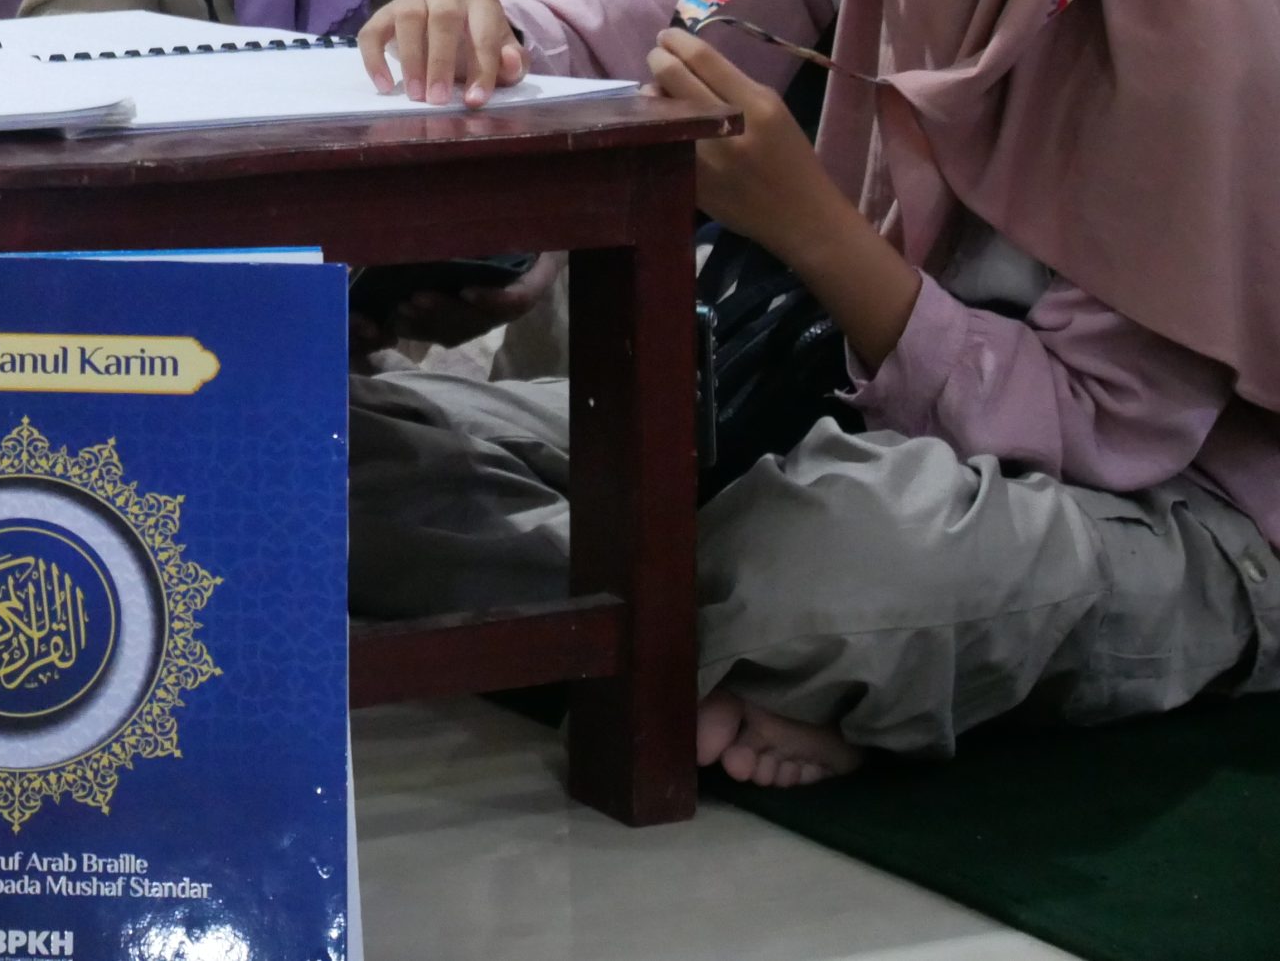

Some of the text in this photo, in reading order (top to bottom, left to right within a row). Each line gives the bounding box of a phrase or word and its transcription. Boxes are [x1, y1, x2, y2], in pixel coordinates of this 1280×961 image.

[79, 346, 179, 377] Karim
[26, 852, 77, 872] Arab
[82, 853, 148, 874] Braille
[46, 875, 127, 897] Mushaf
[130, 877, 212, 899] Standar
